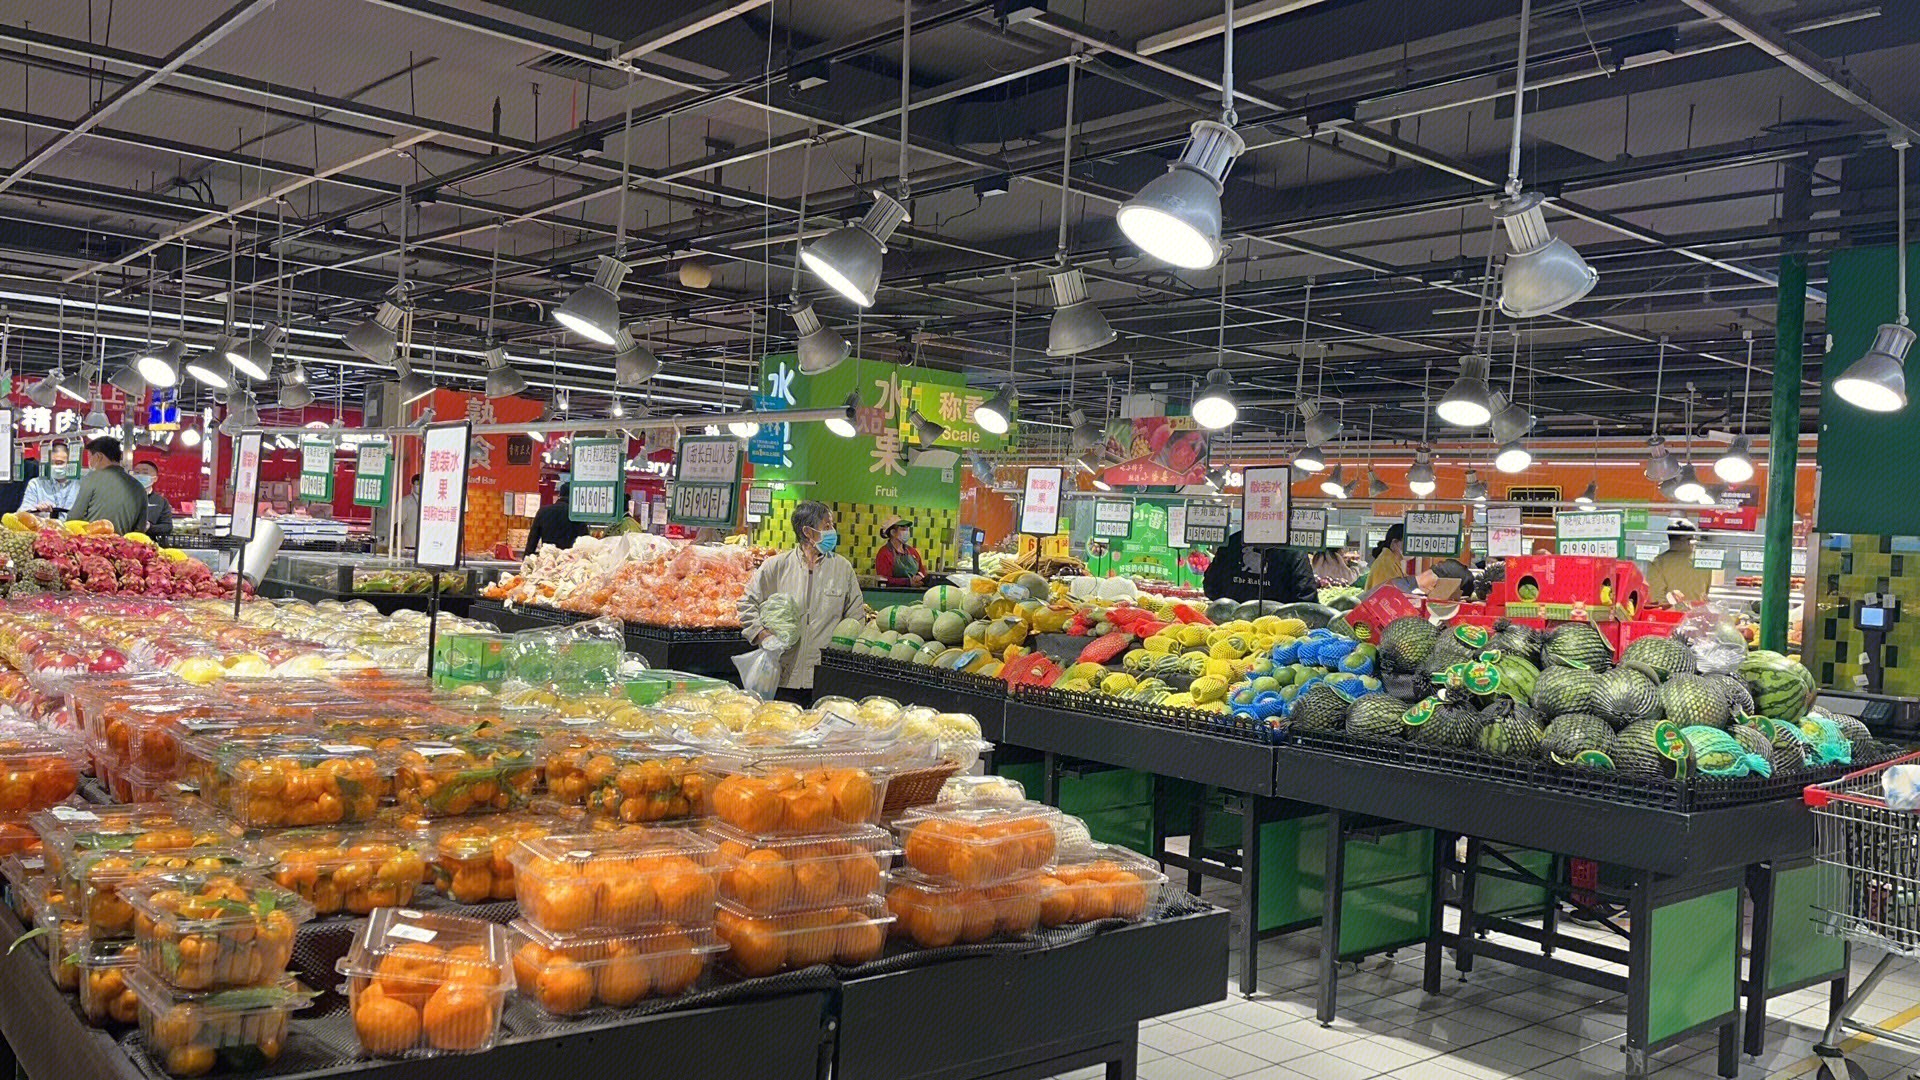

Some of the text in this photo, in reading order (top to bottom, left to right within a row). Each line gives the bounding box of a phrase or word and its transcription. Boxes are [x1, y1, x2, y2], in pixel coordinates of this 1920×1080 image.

[939, 391, 984, 423] 称重
[22, 406, 80, 434] 精肉
[941, 425, 980, 443] Scale
[430, 450, 460, 472] 散装水
[481, 476, 497, 485] Bar
[1250, 480, 1282, 494] 散装水
[437, 478, 448, 500] 果
[875, 485, 898, 498] Fruit
[1260, 496, 1271, 508] 果
[1291, 510, 1321, 521] 洋瓜
[1232, 576, 1271, 587] The Rabit
